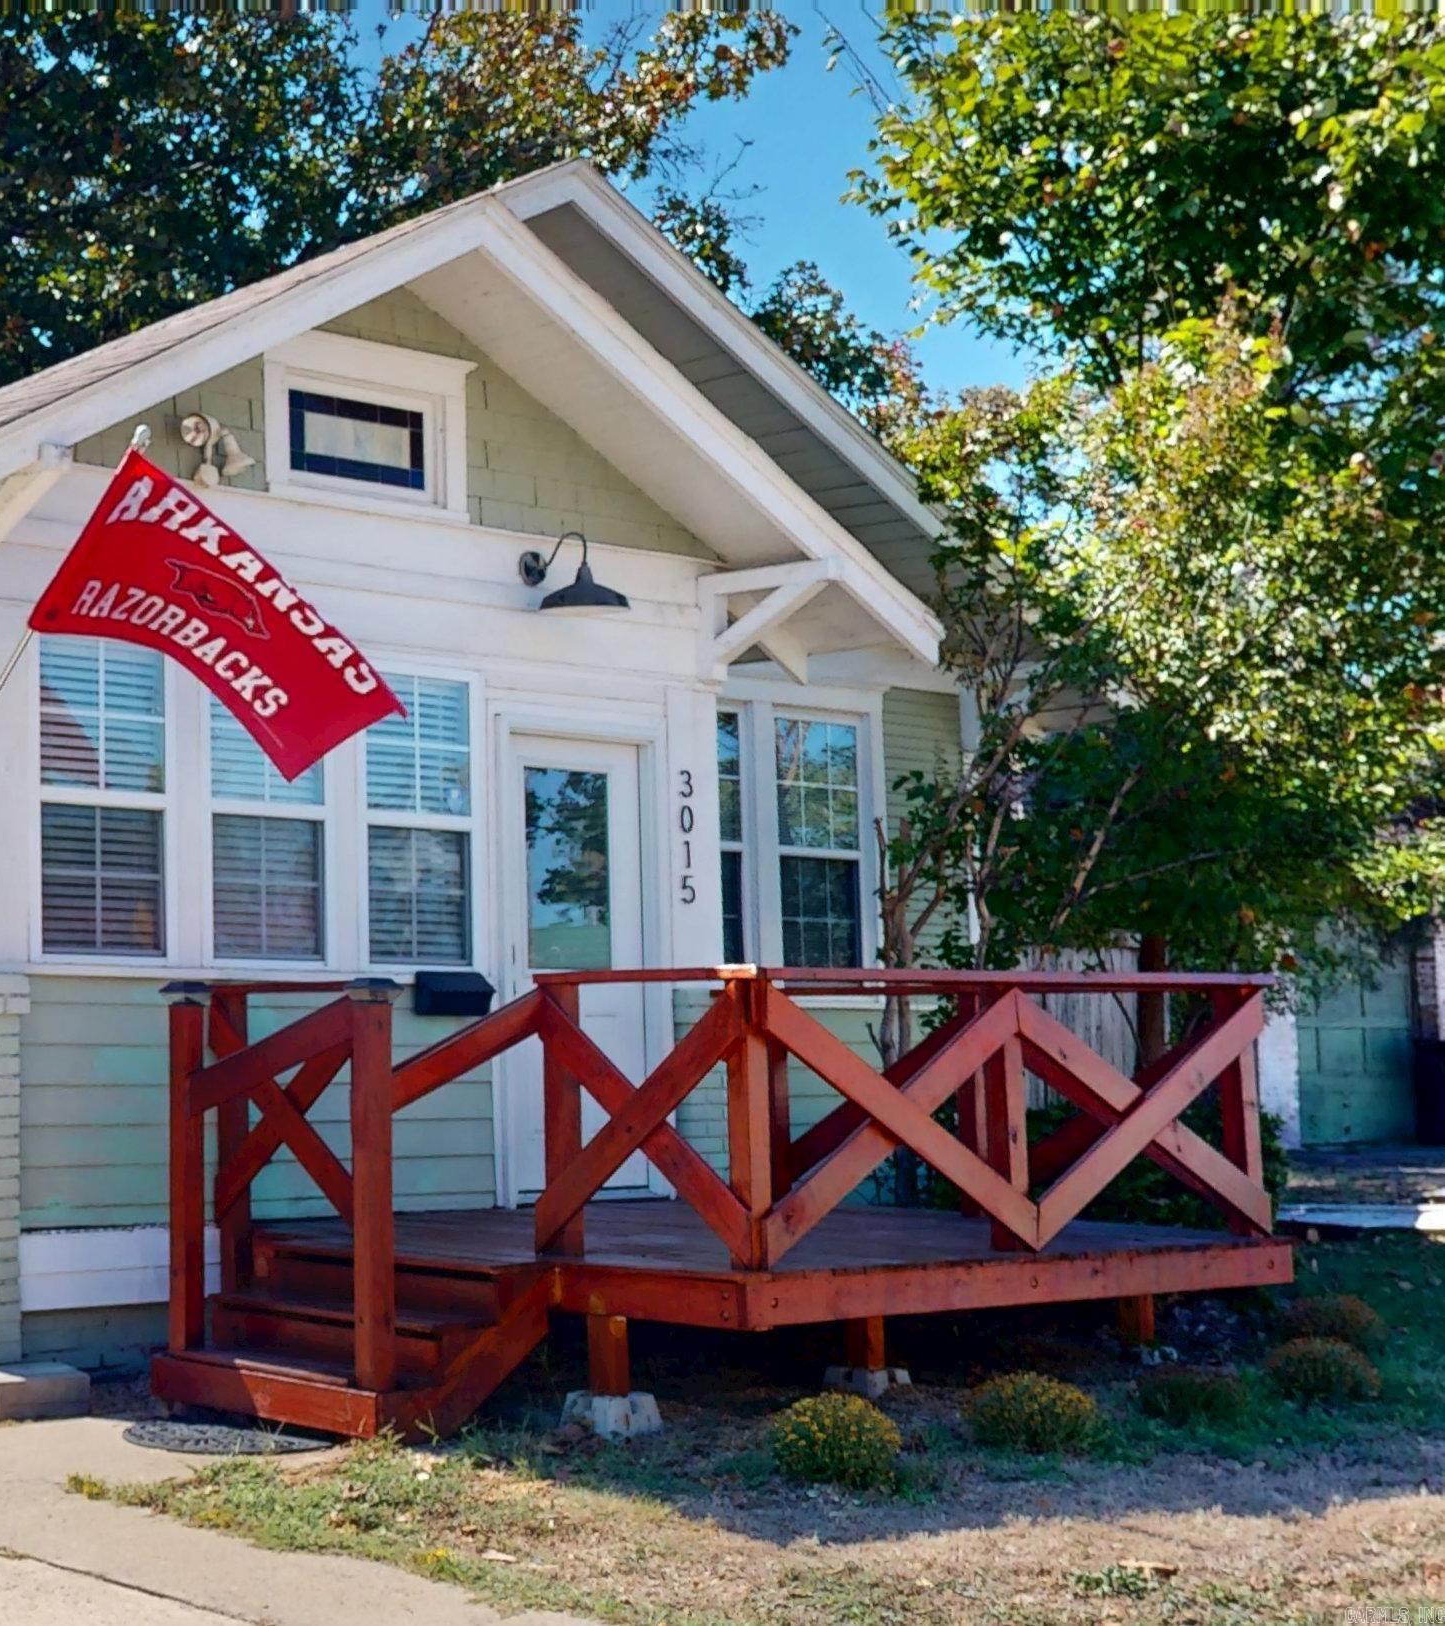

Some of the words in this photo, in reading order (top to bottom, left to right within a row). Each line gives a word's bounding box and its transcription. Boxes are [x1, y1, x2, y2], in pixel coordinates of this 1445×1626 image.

[71, 580, 289, 718] RAZORBACKS
[106, 475, 378, 695] ARKANSAS
[679, 769, 696, 904] 3015
